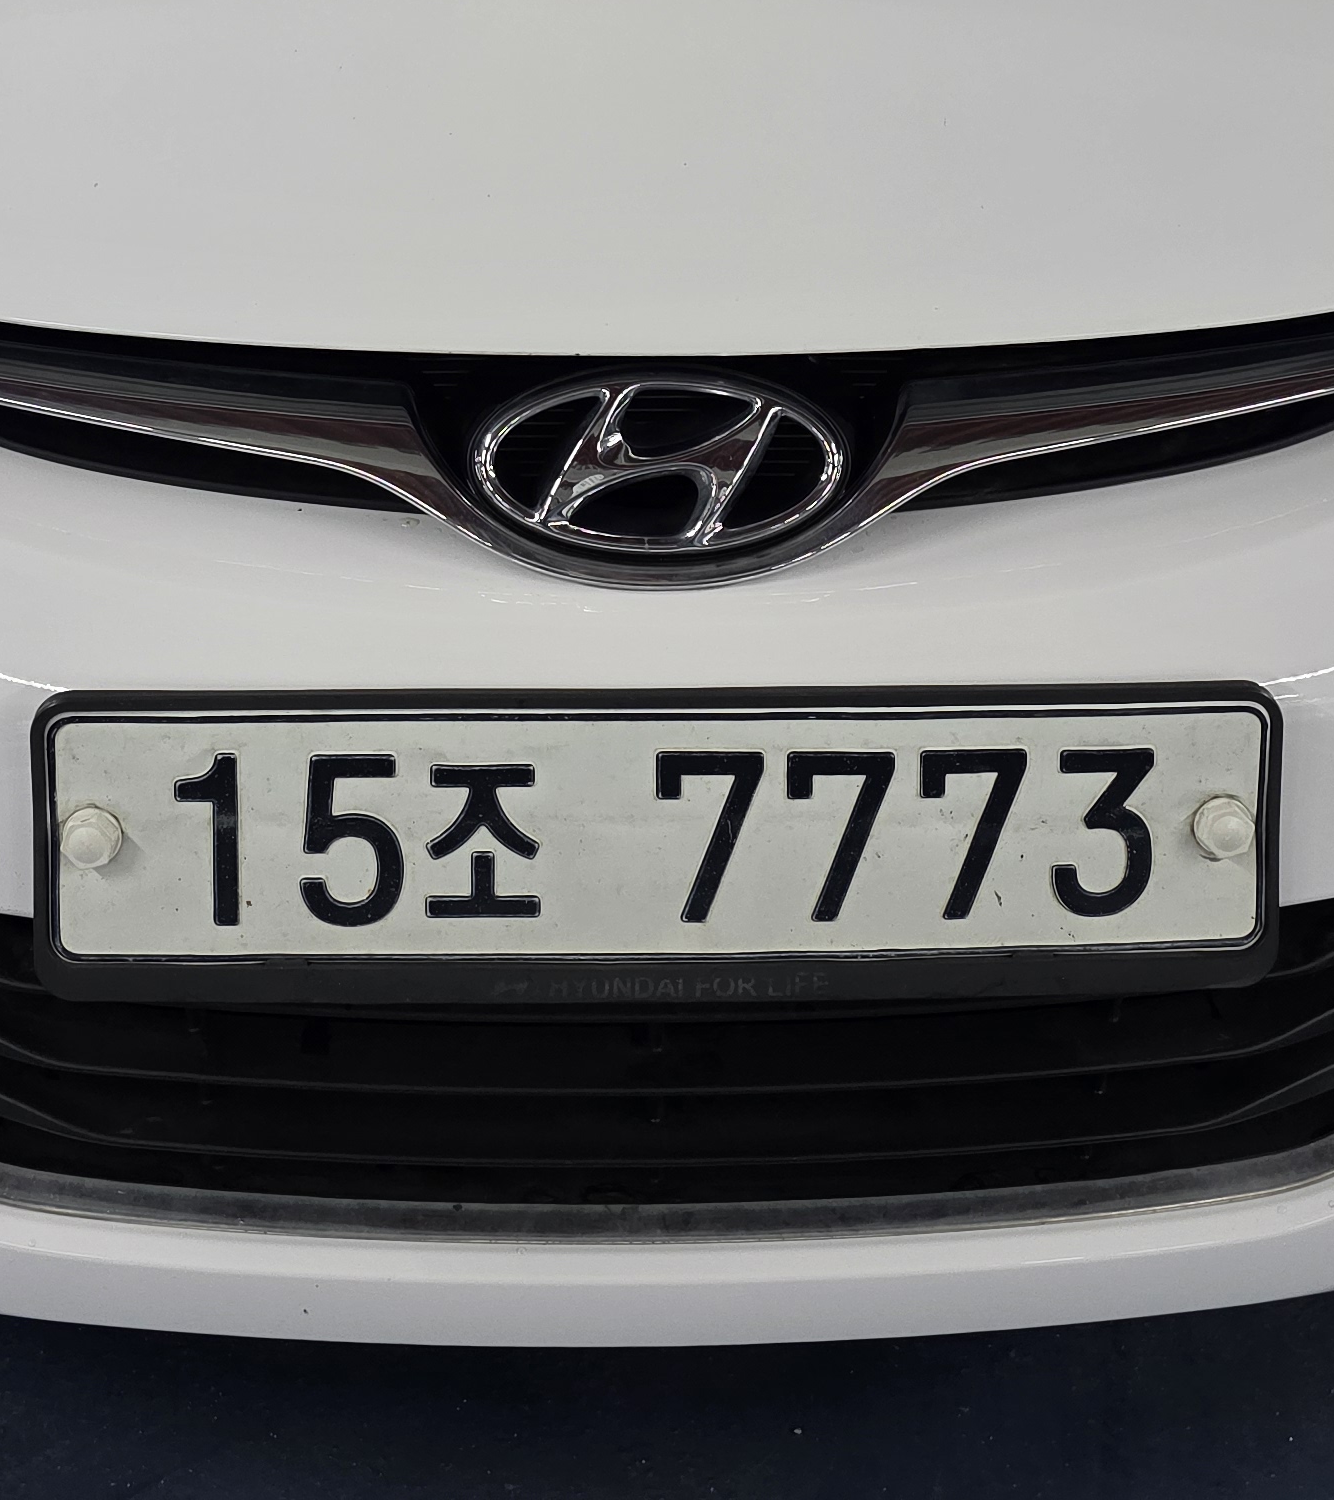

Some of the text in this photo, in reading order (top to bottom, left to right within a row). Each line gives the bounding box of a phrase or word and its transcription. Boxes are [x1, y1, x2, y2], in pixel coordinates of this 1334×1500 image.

[173, 746, 1157, 928] 15조 7773
[547, 972, 830, 999] HYUNDAI FOR LIFE
